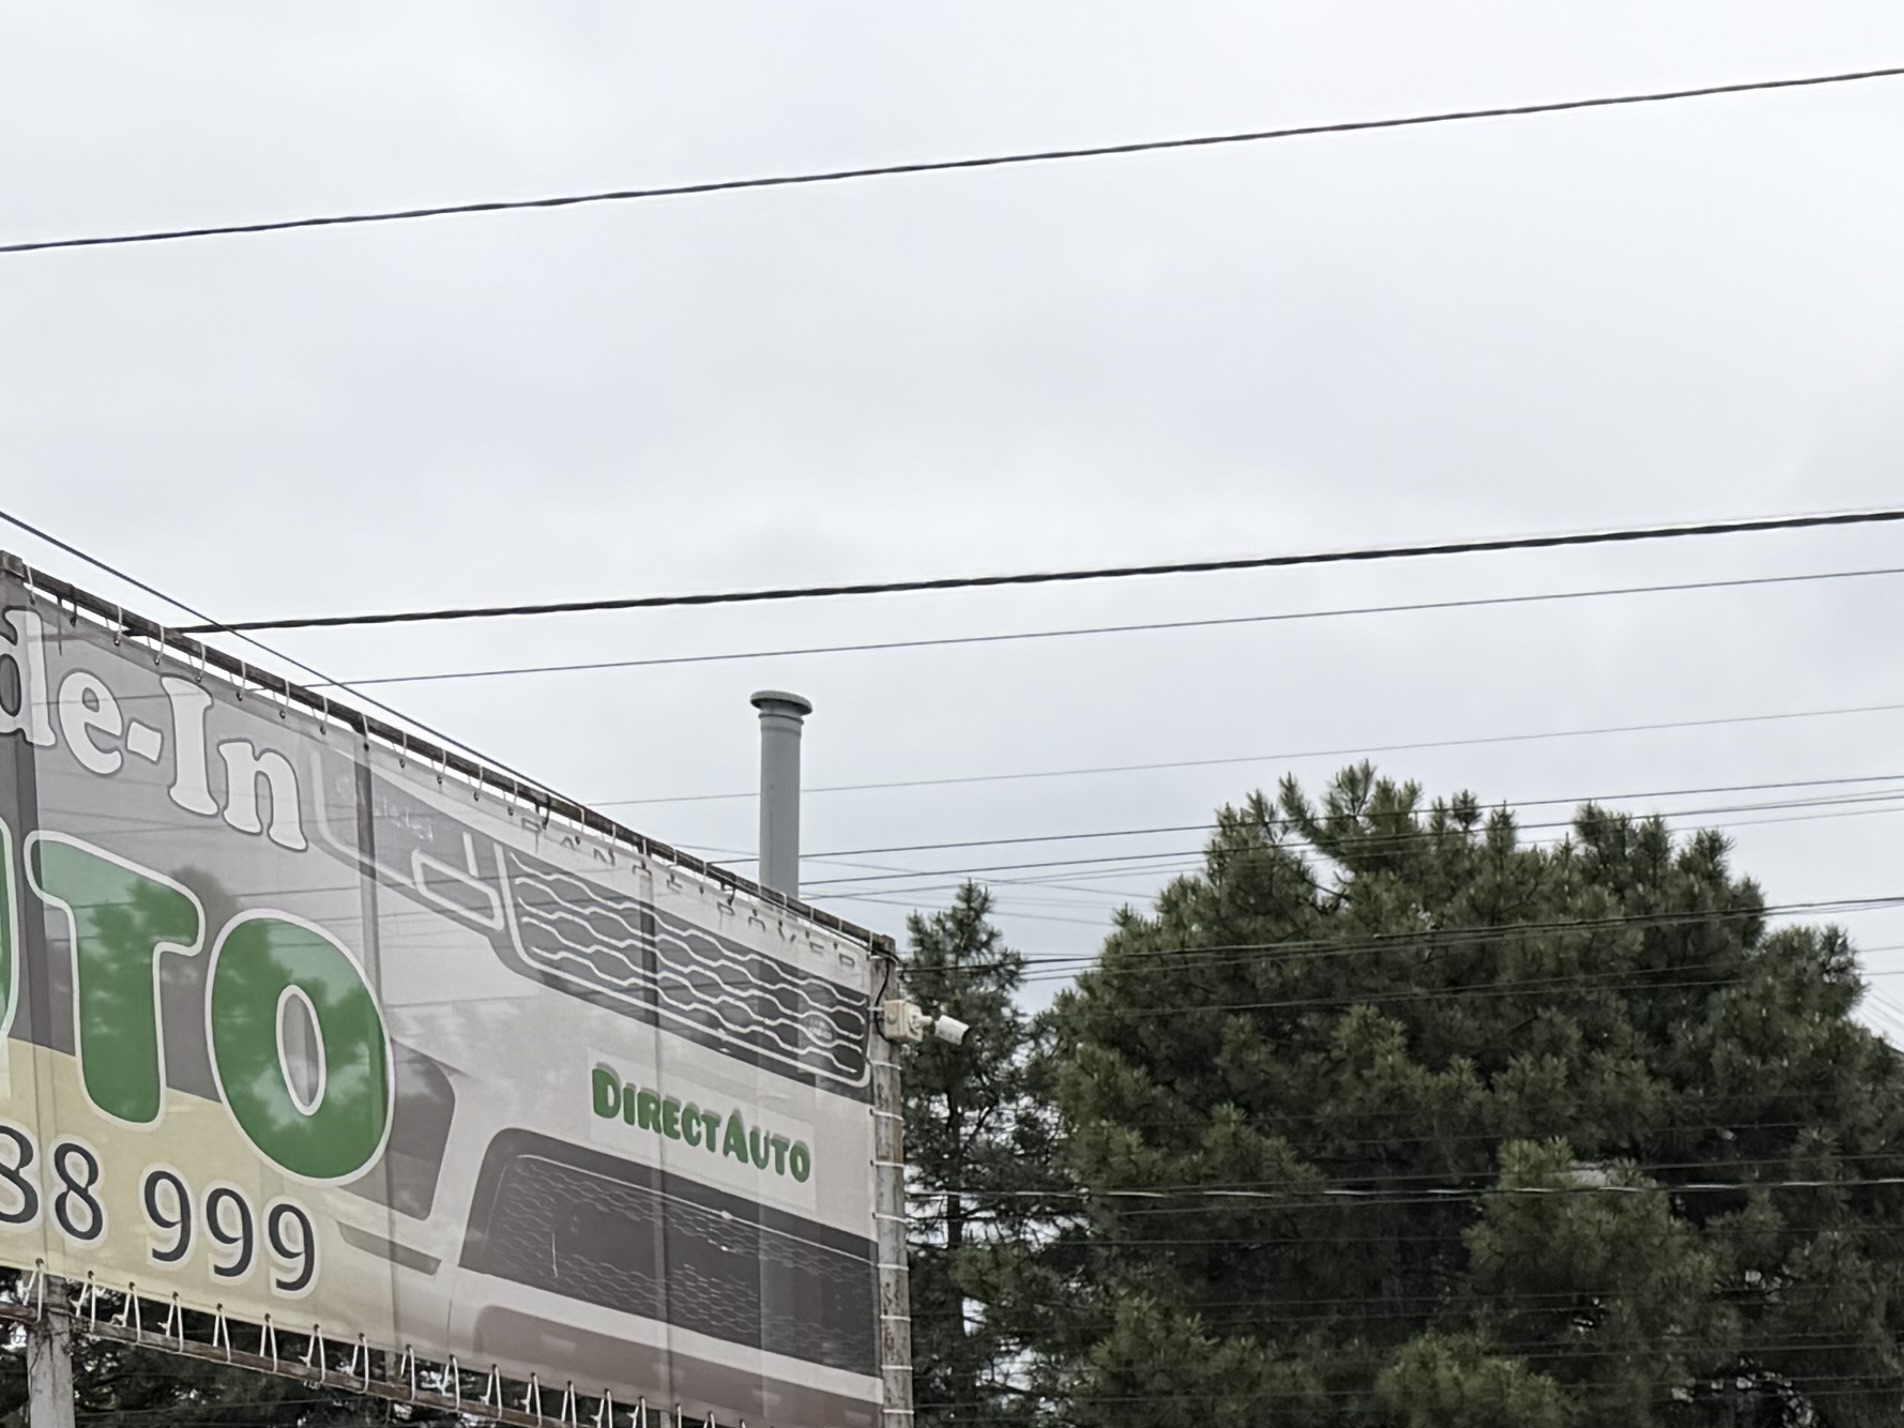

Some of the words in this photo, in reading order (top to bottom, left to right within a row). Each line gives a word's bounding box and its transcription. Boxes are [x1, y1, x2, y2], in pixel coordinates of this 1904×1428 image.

[0, 815, 394, 1188] TO
[591, 1063, 811, 1184] DIRECTAUTO
[143, 1170, 316, 1292] 999
